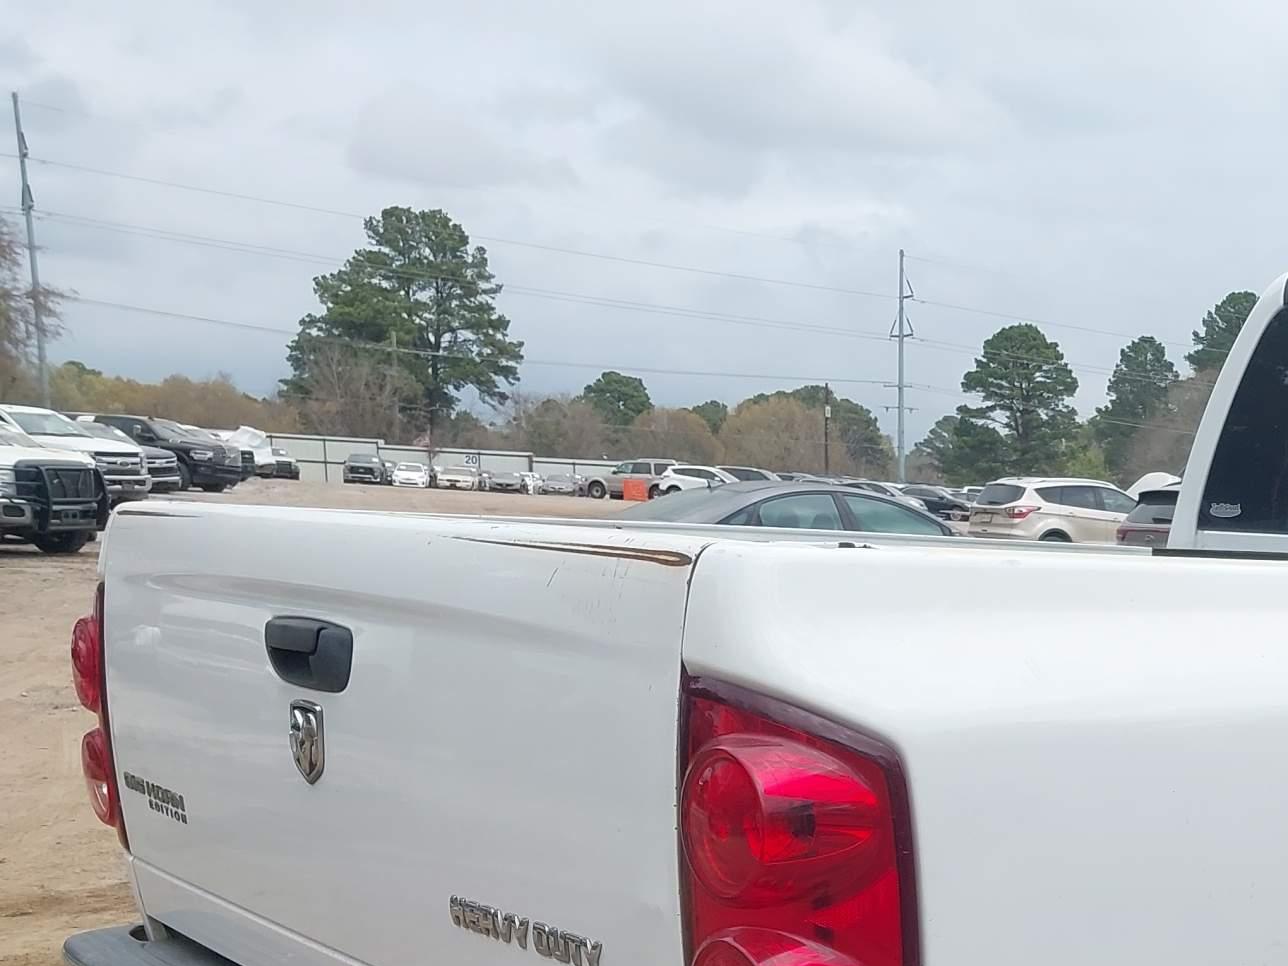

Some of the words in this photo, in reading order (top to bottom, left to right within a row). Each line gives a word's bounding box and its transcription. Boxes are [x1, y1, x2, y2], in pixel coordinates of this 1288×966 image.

[465, 455, 478, 465] 20
[149, 799, 188, 825] EDITION
[450, 894, 530, 950] HEAVY
